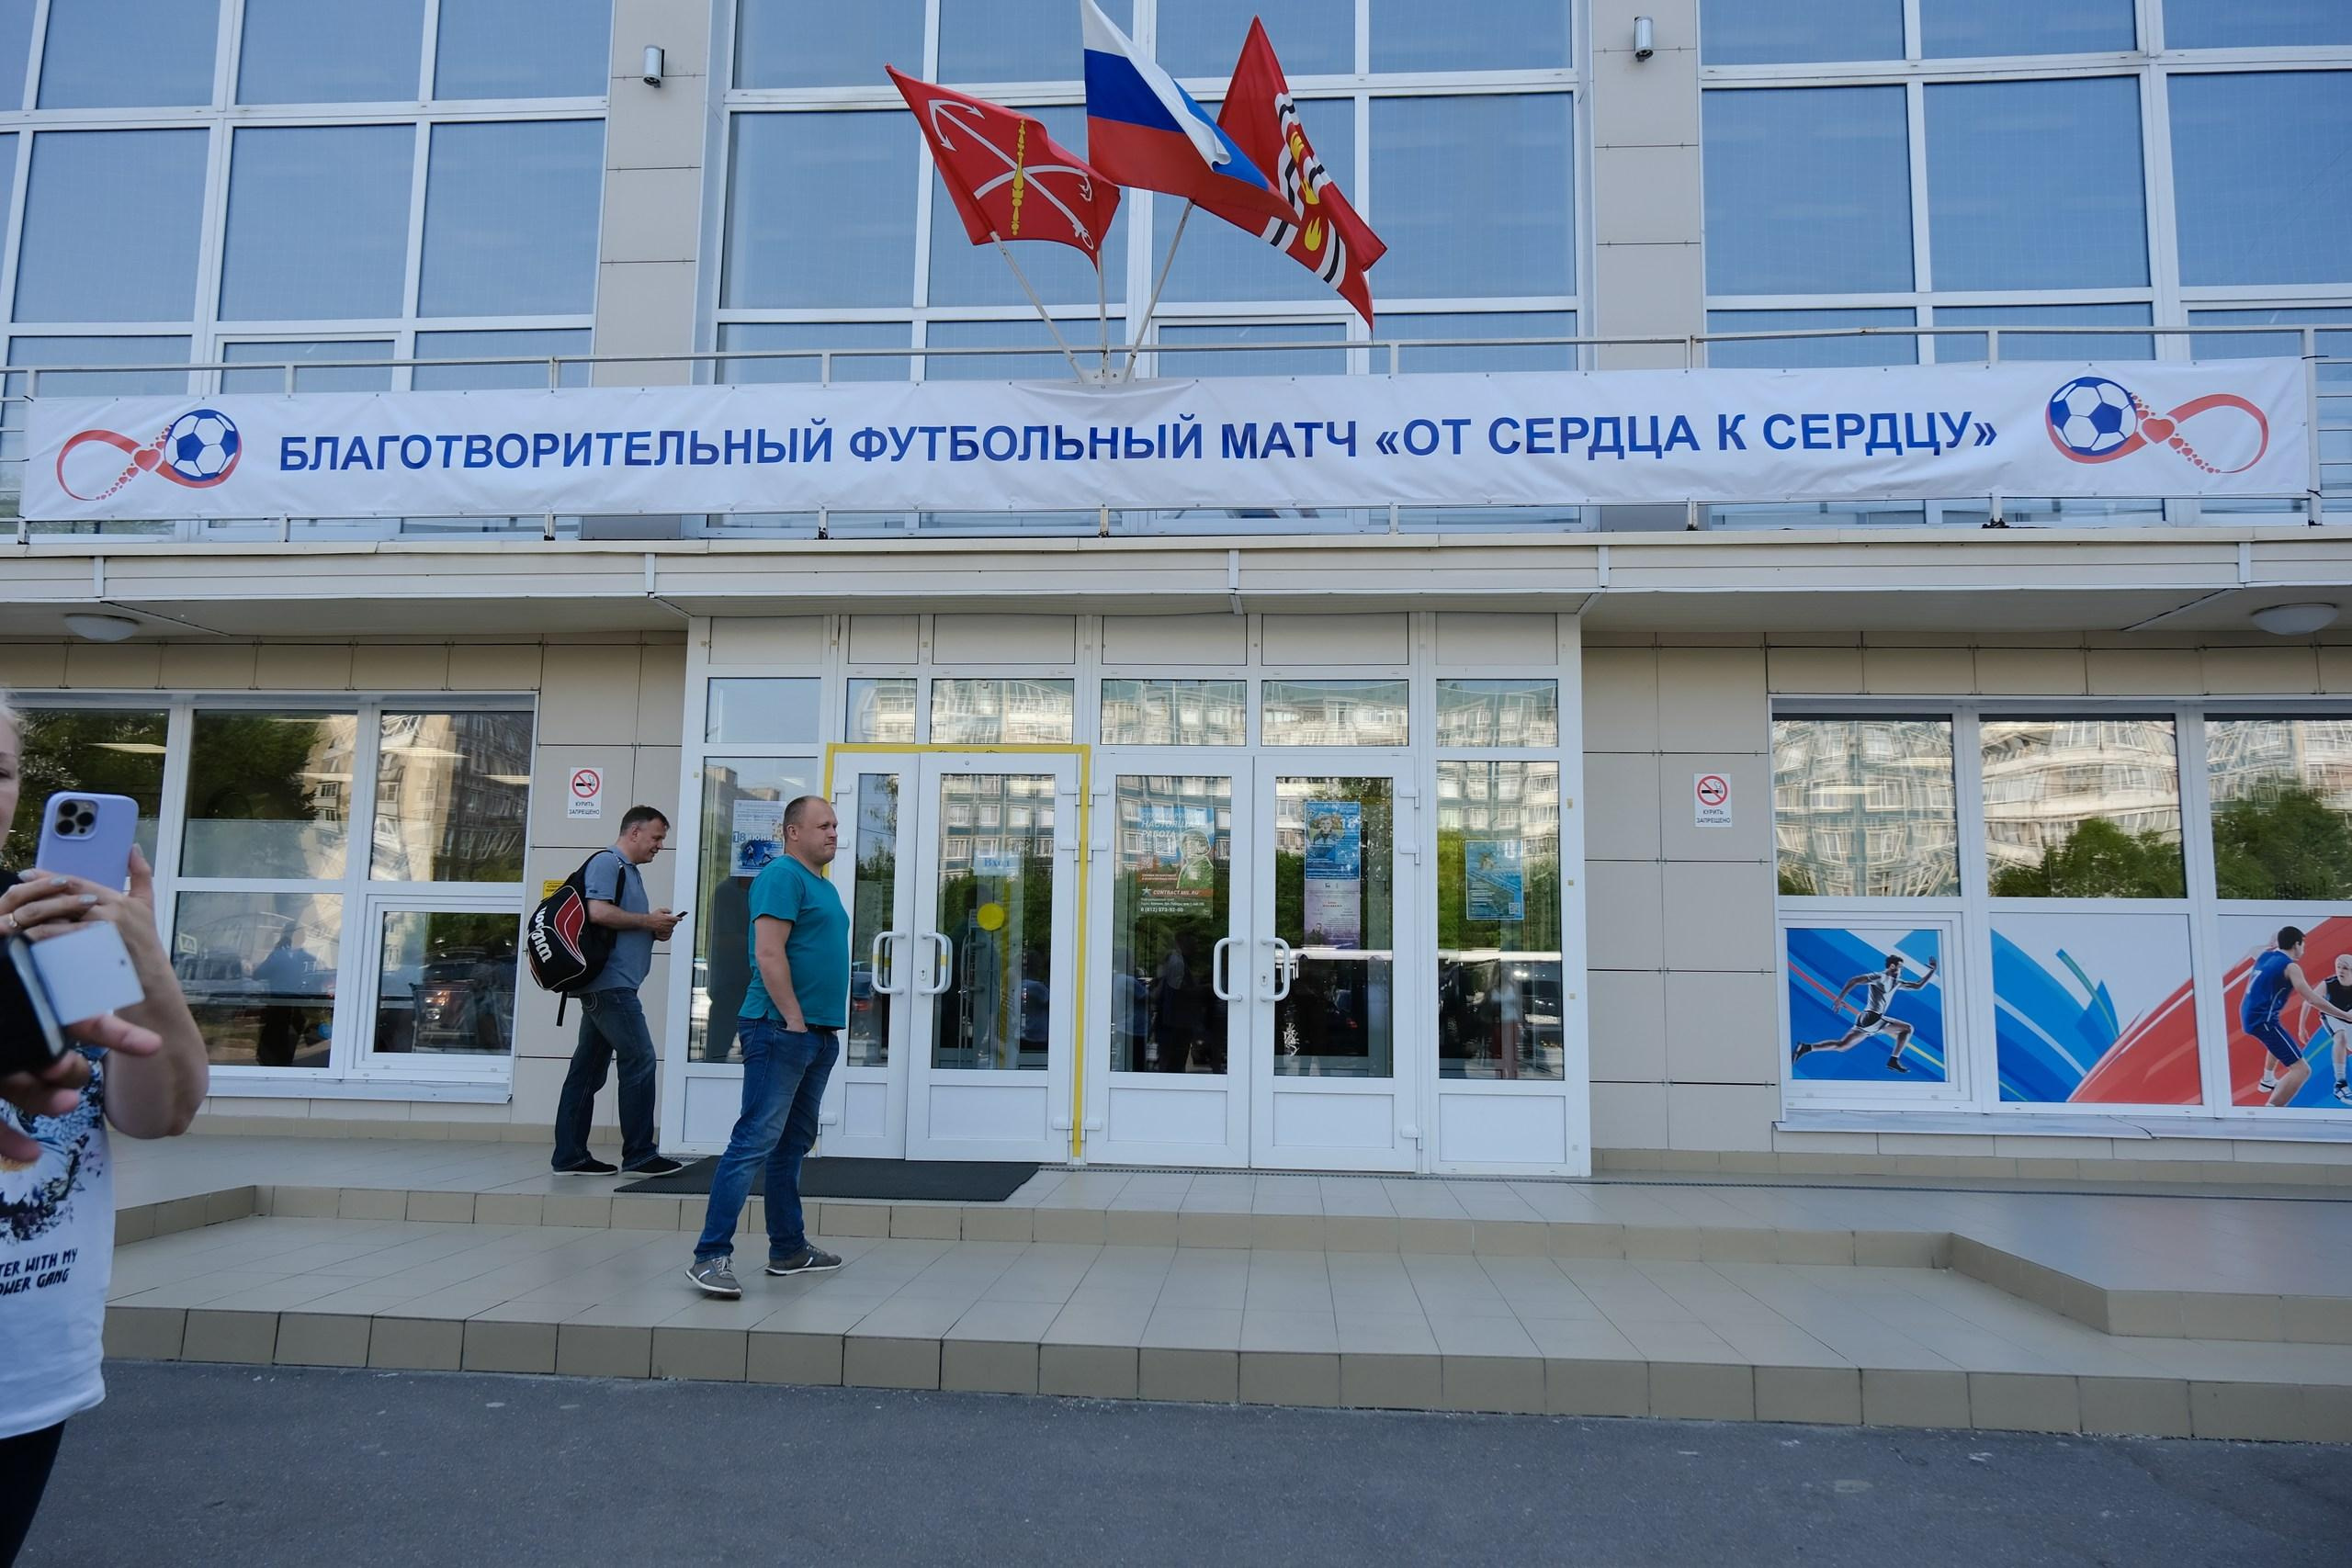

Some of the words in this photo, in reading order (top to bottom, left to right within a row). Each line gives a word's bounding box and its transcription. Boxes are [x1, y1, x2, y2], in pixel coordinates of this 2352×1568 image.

[278, 417, 833, 471] БЛАГОТВОРИТЕЛЬНЫЙ
[849, 412, 1199, 462] ФУТБОЛЬНЫЙ
[1220, 420, 1357, 460] МАТЧ
[1374, 417, 1471, 457] «ОТ
[1487, 413, 1700, 461] СЕРДЦА
[1718, 412, 1747, 451] К
[1762, 411, 1998, 457] СЕРДЦУ»
[25, 1252, 58, 1273] WITH
[62, 1247, 79, 1265] MY
[36, 1268, 70, 1289] GANG
